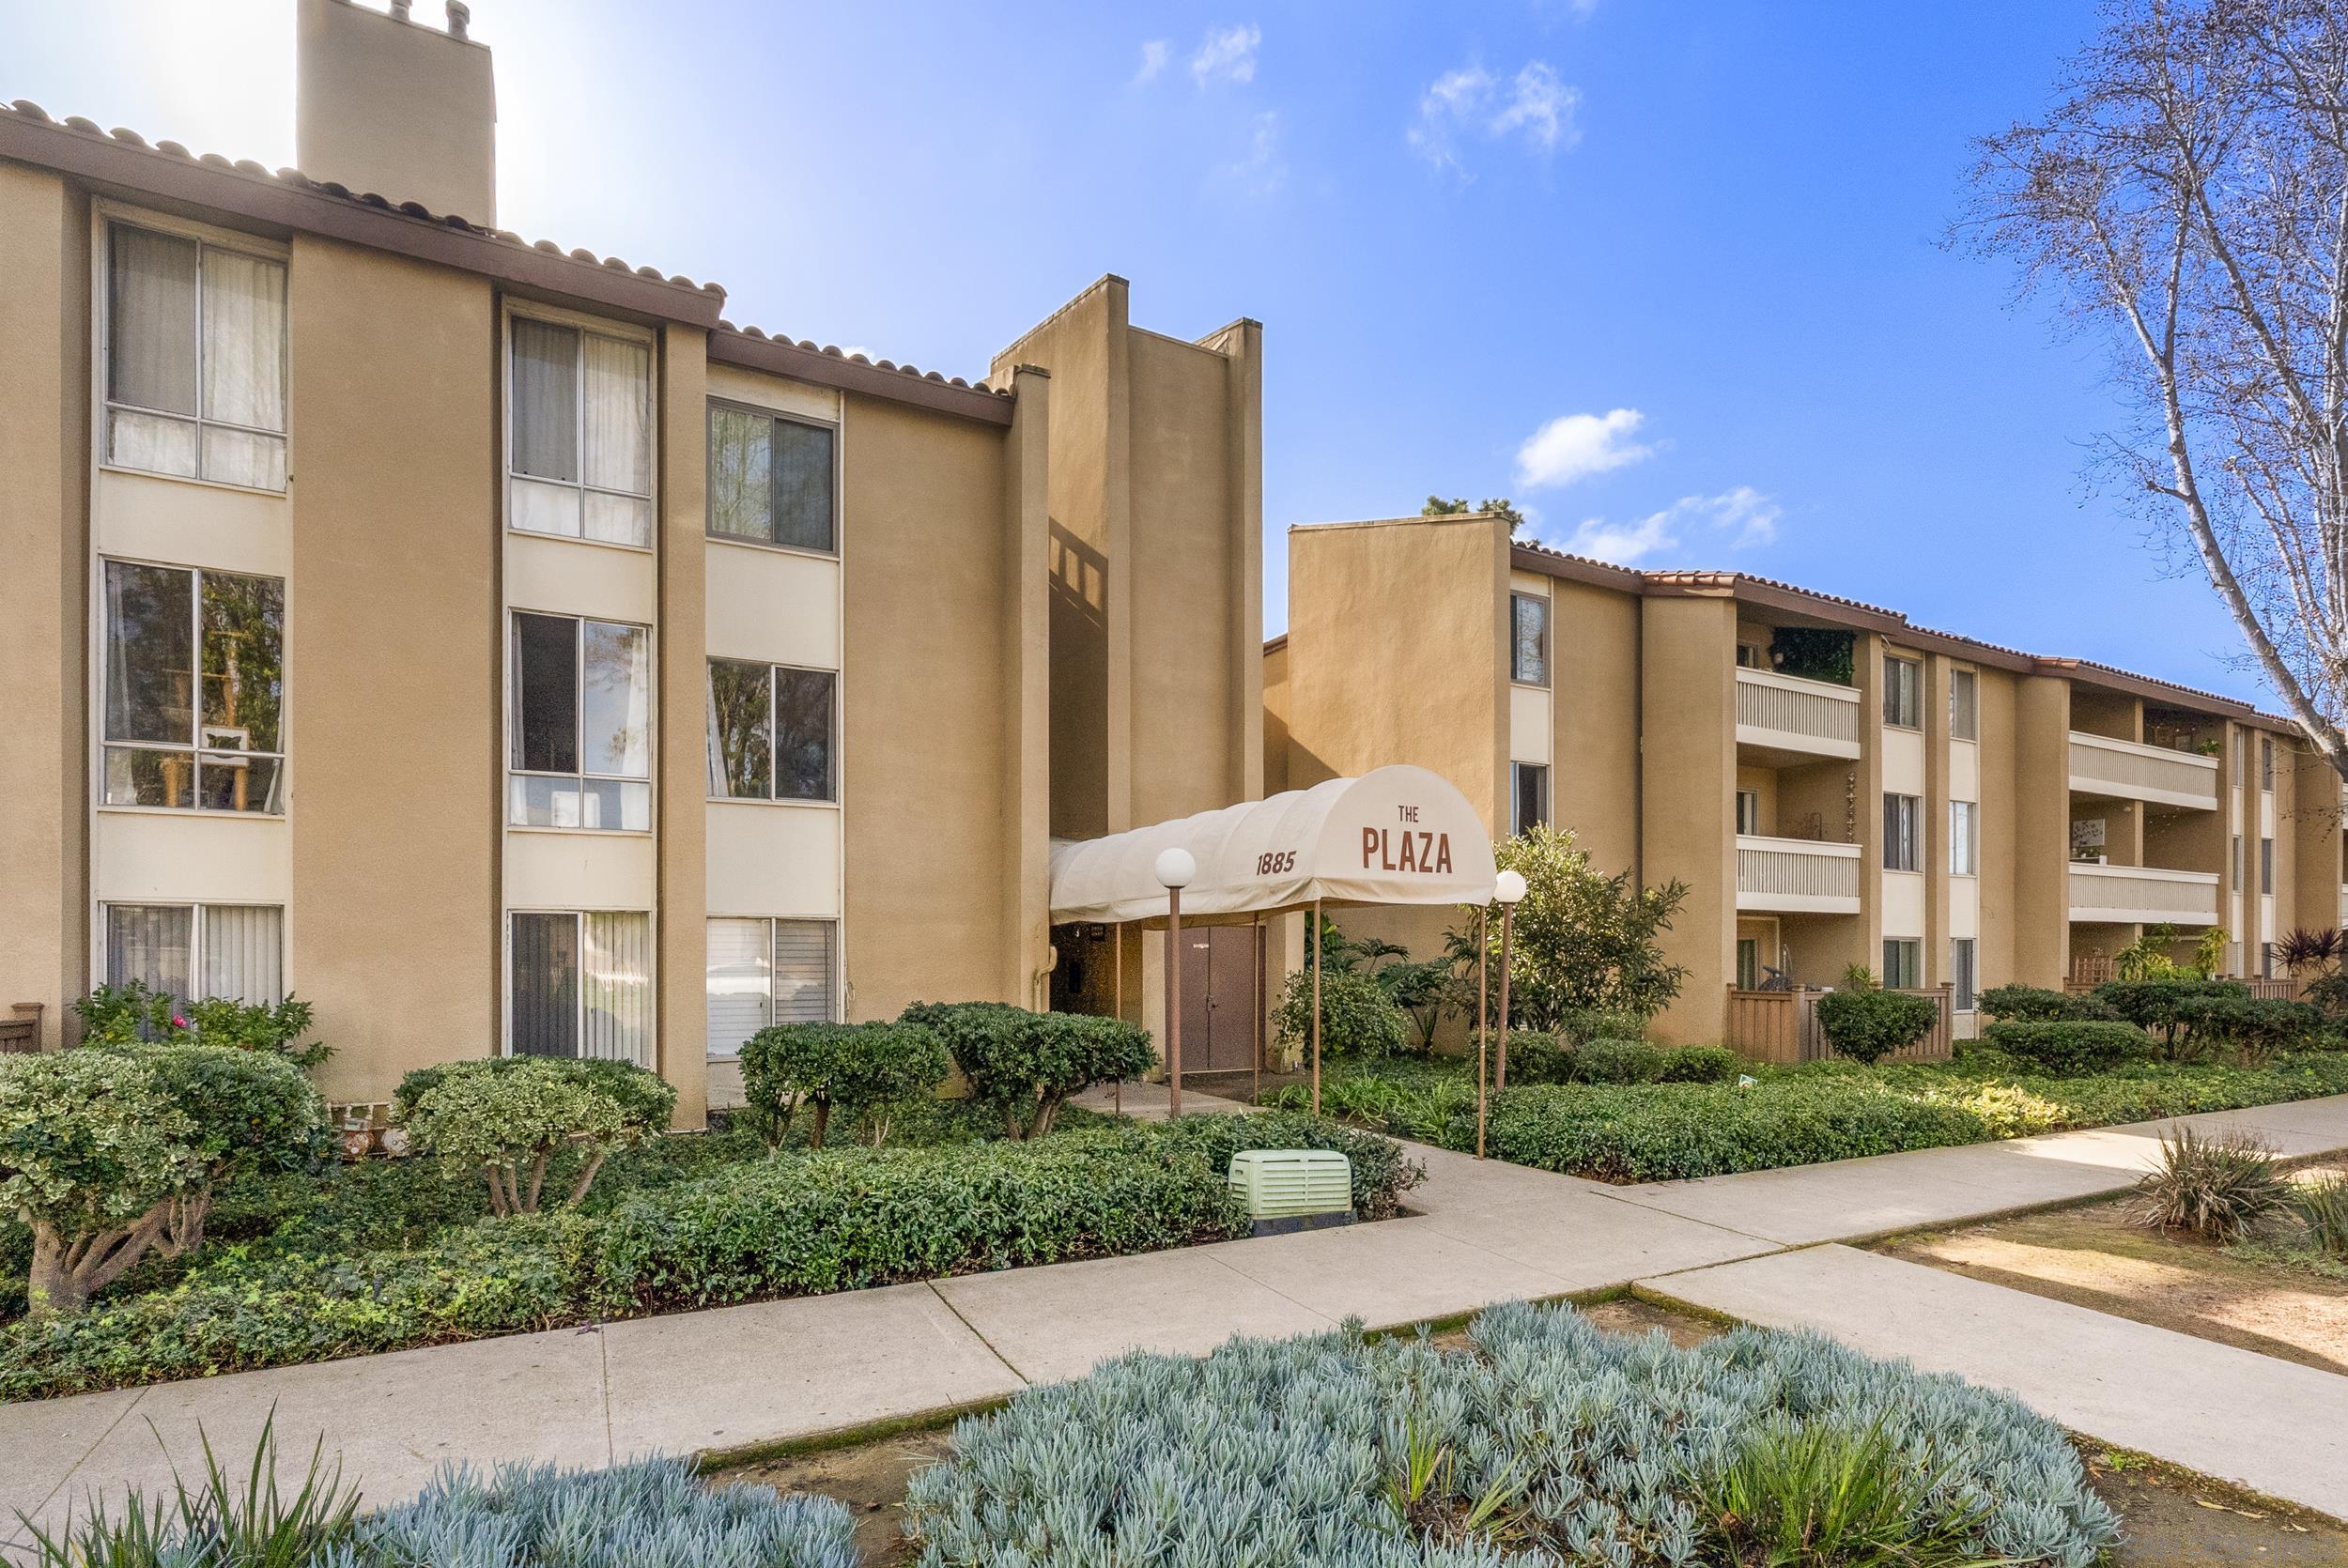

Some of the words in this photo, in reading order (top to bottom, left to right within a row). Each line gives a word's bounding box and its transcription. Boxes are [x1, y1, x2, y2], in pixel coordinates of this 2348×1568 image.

[1398, 806, 1418, 822] THE
[1363, 827, 1452, 873] PLAZA
[1257, 851, 1296, 875] 1885
